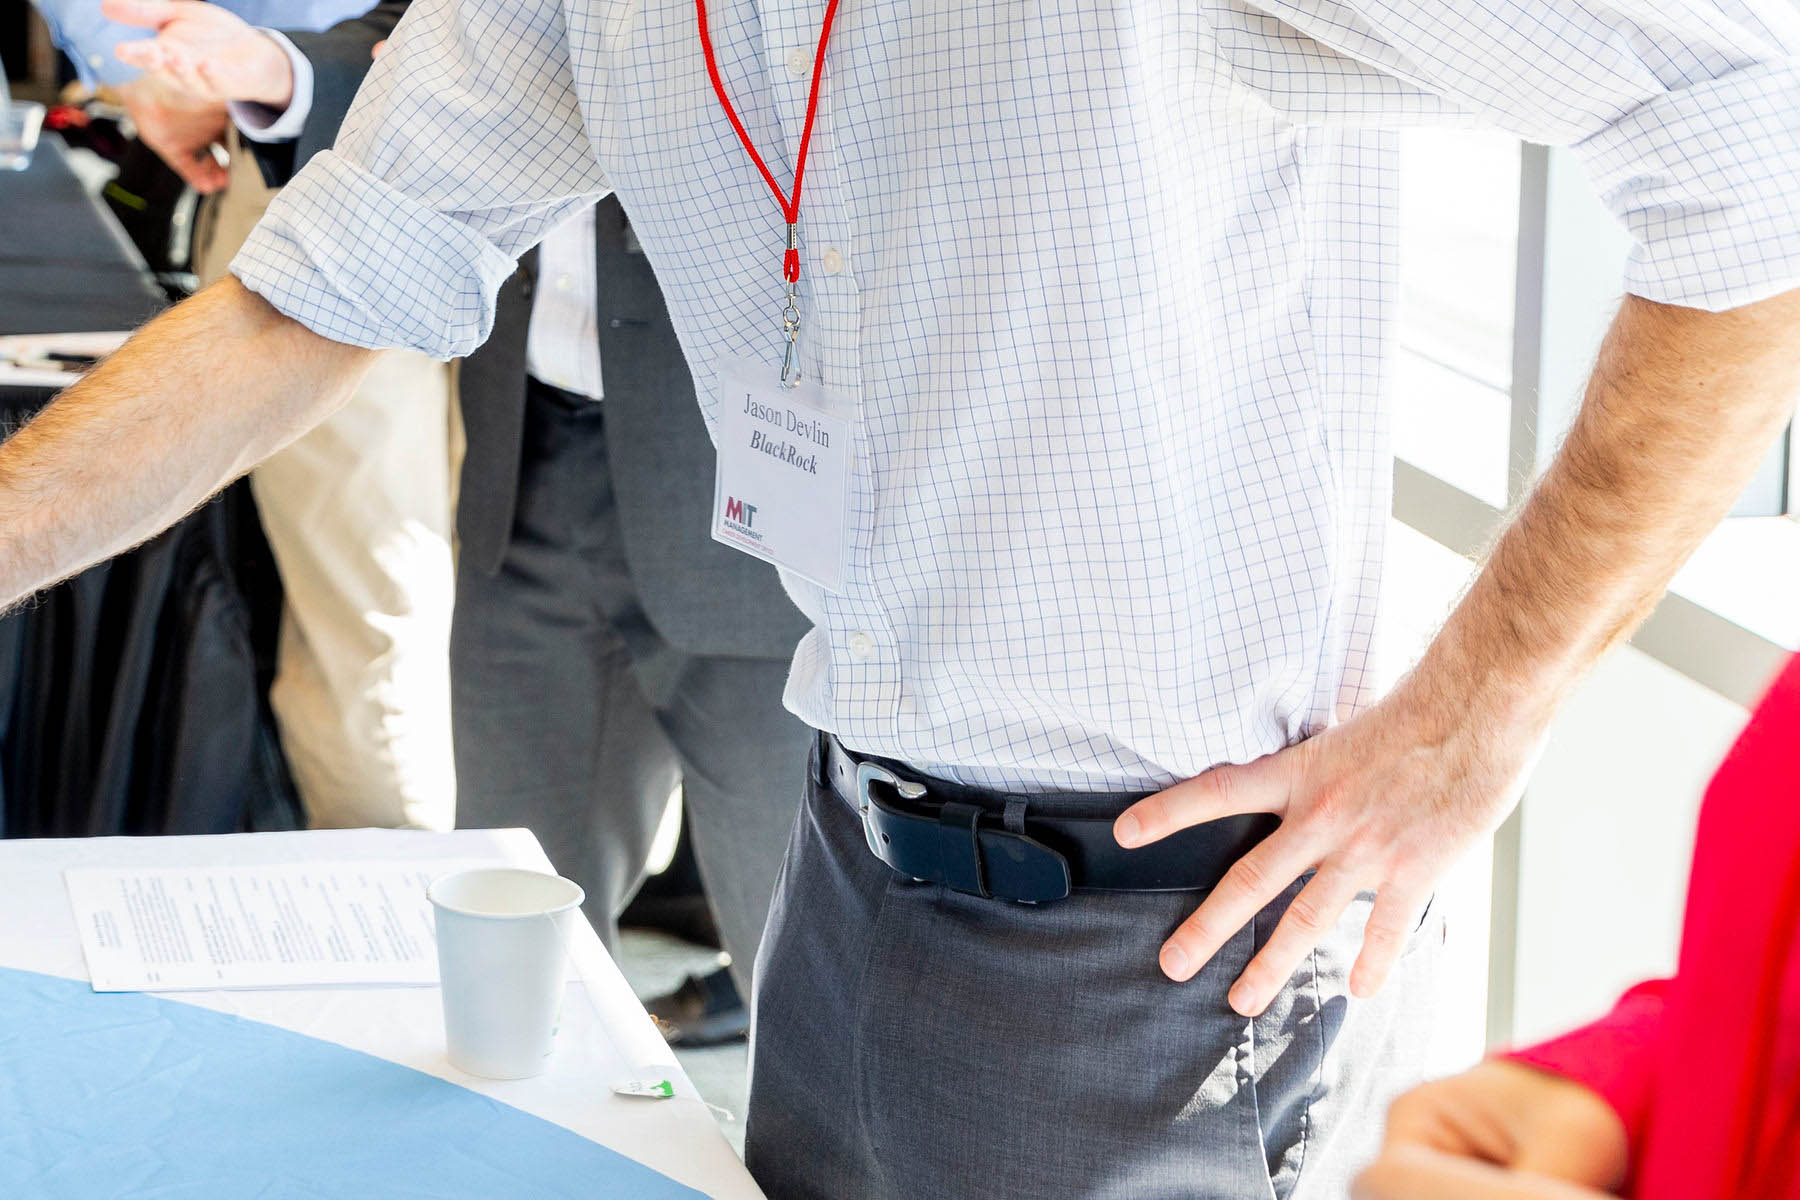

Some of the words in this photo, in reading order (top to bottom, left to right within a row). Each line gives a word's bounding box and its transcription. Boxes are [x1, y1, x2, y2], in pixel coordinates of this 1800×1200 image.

[744, 394, 782, 427] Jason
[786, 410, 830, 448] Devlin
[750, 430, 817, 474] BlackRock
[724, 519, 764, 542] MANAGEMENT
[725, 496, 757, 528] MIT
